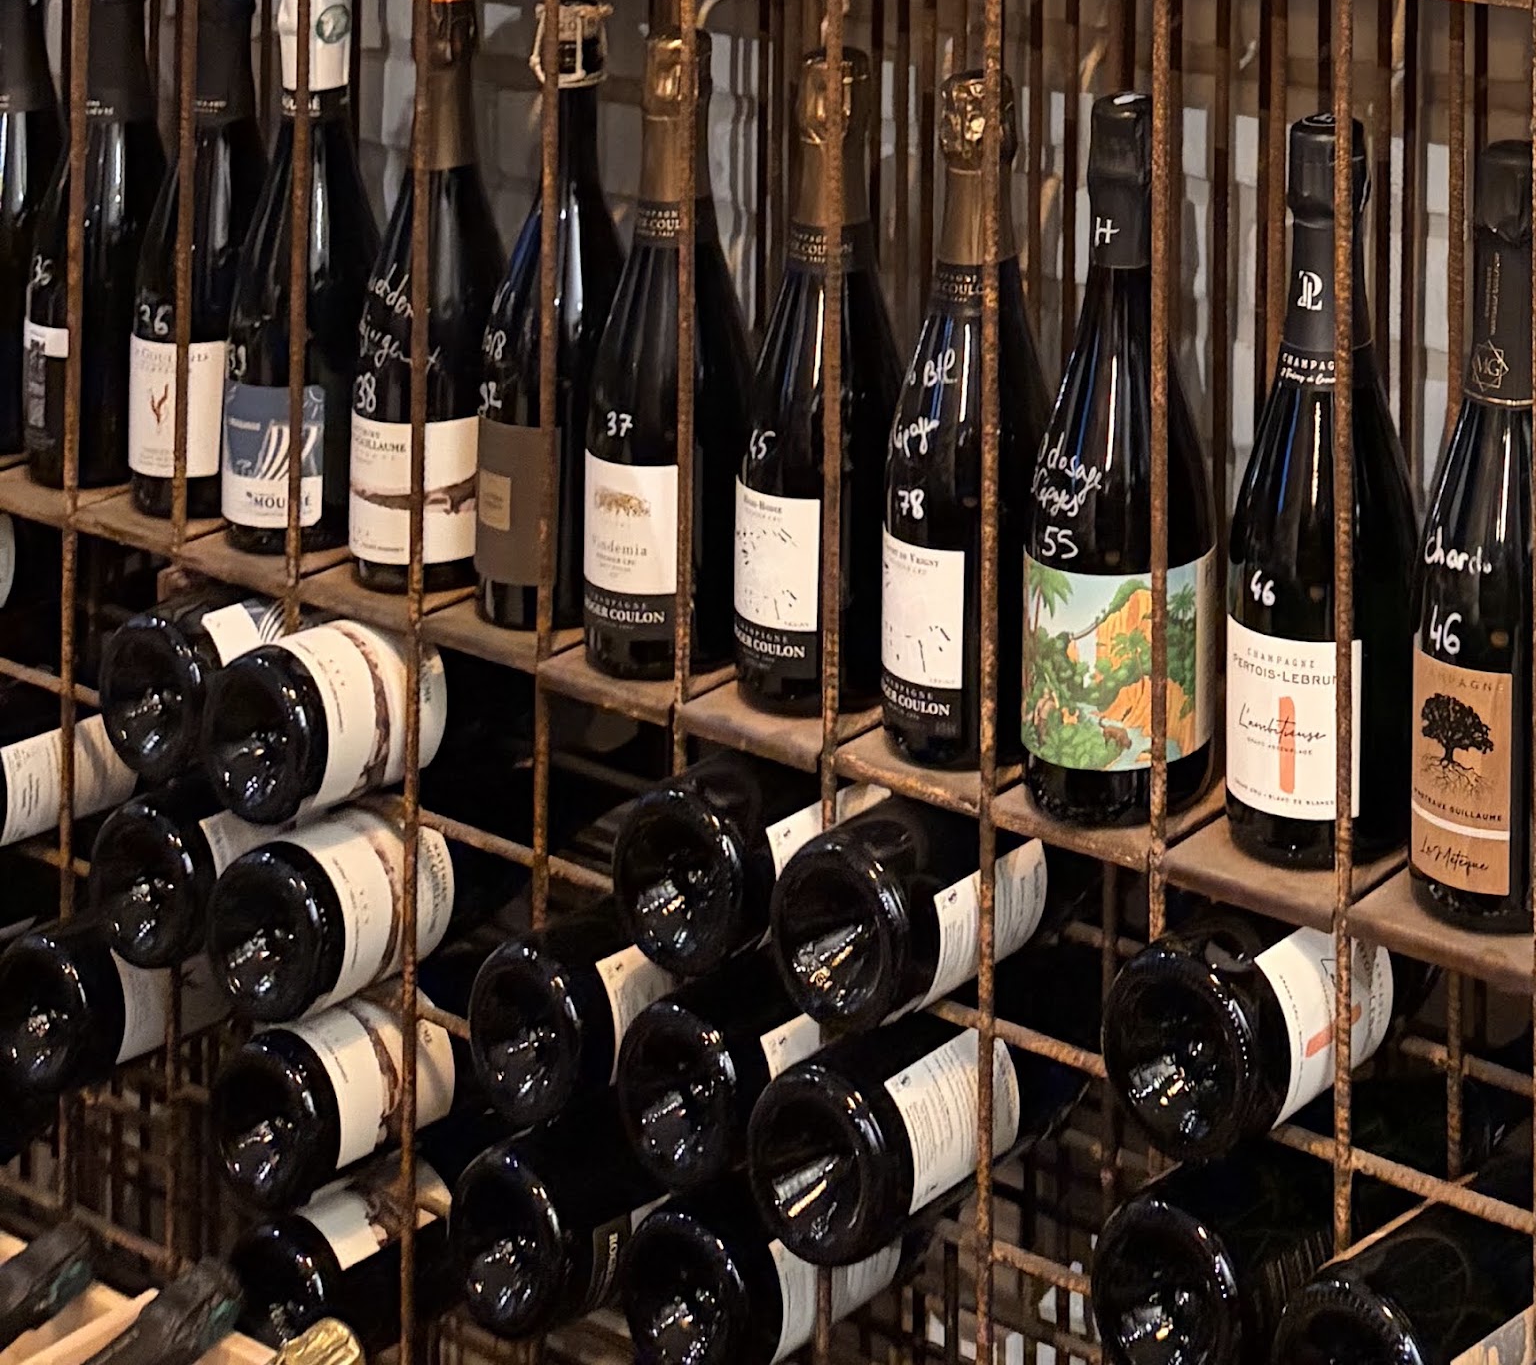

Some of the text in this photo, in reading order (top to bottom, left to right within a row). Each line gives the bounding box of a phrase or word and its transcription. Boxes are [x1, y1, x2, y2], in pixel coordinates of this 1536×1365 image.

[606, 410, 634, 438] 37
[253, 490, 312, 509] MOUÉ
[897, 488, 925, 520] 78
[1249, 569, 1277, 607] 46
[609, 607, 666, 625] COULON
[1429, 604, 1462, 656] 46
[753, 636, 806, 659] COULON
[1247, 647, 1316, 669] CHAMPAGNE
[898, 695, 951, 717] COULON
[1449, 805, 1503, 822] GUILLAUME
